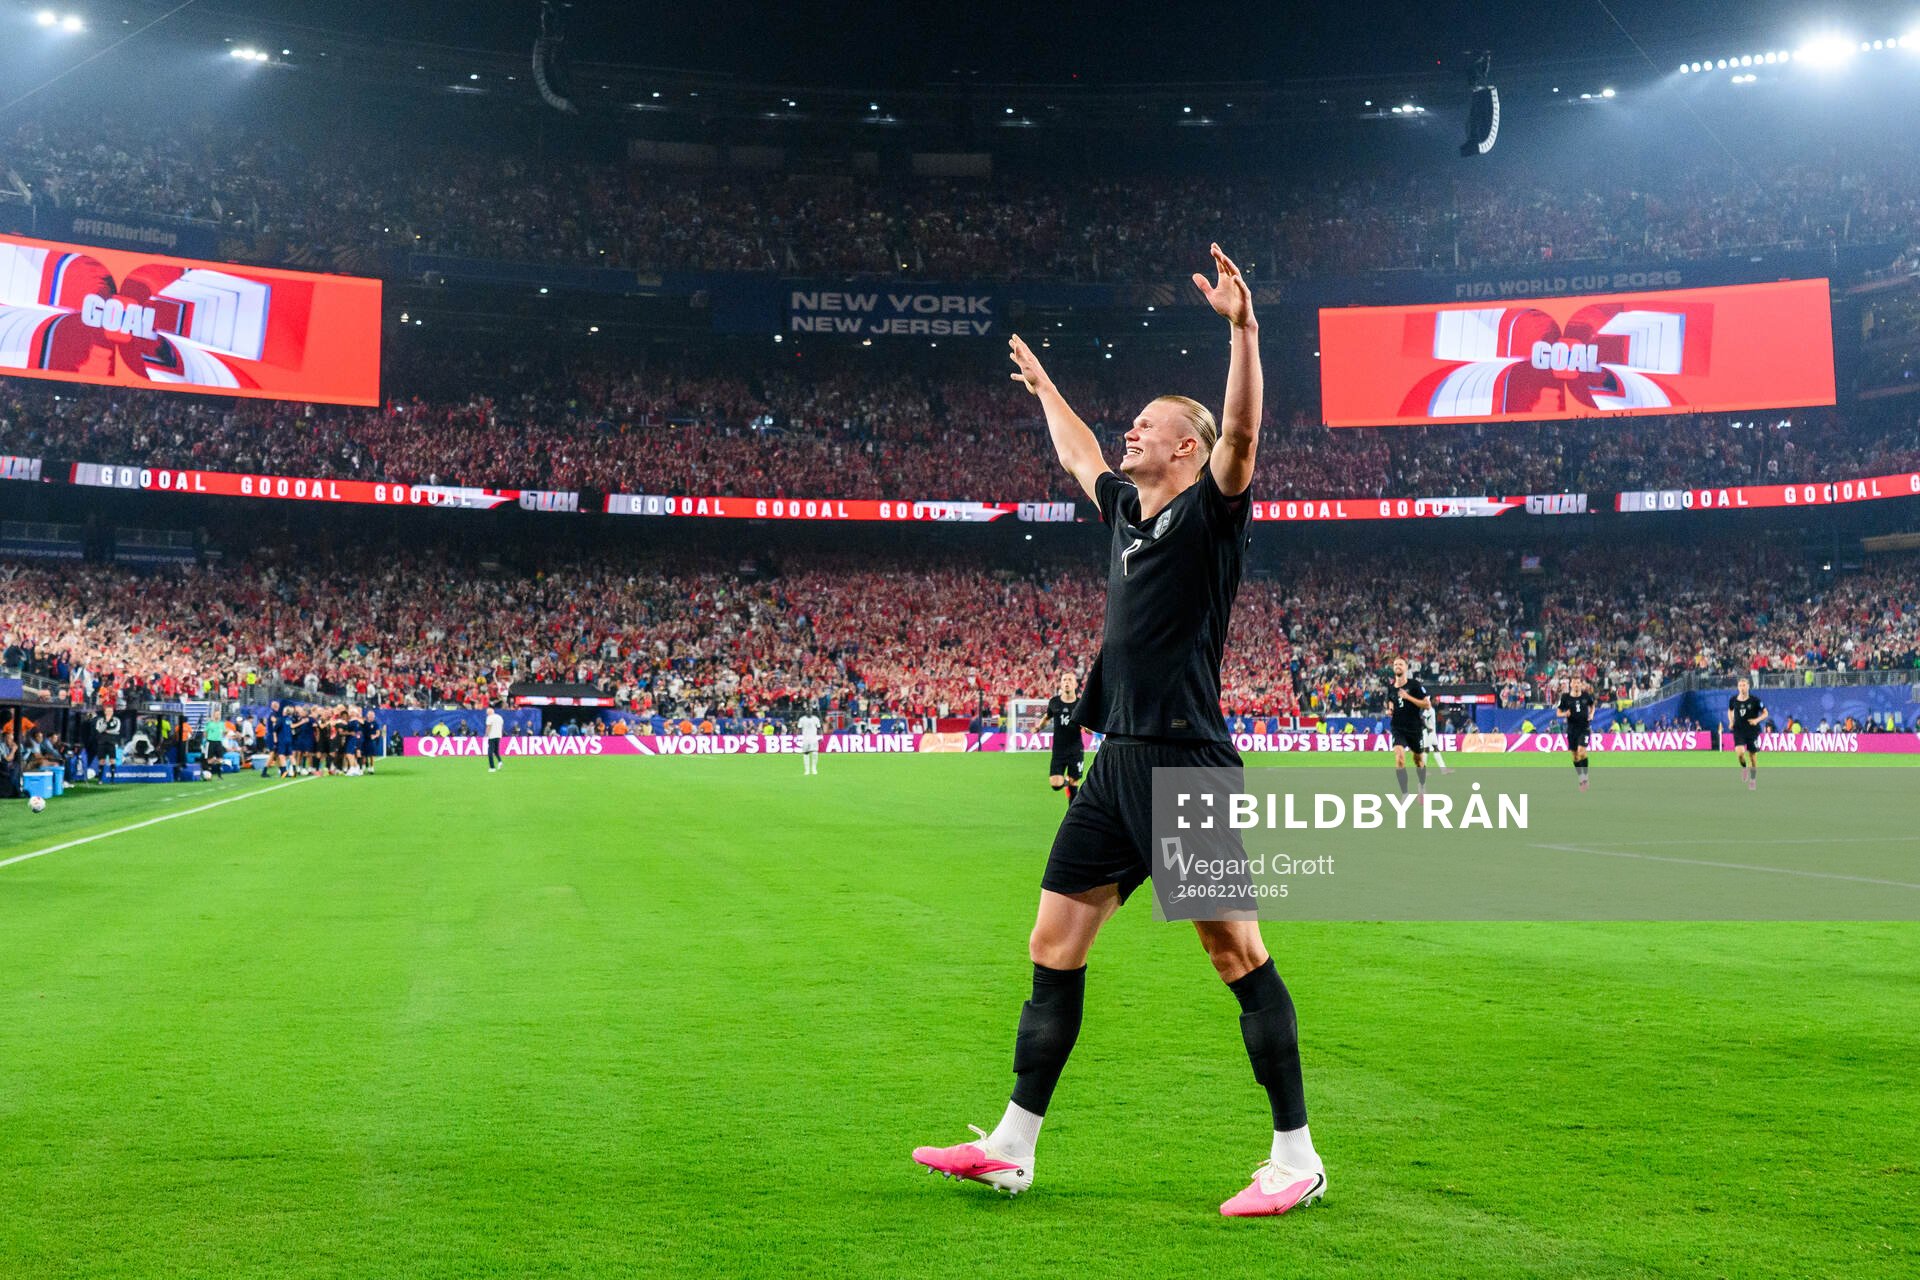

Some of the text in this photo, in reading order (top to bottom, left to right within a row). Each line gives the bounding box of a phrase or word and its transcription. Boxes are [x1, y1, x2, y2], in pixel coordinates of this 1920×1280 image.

[73, 218, 177, 248] #FIFAWorldCup
[1455, 271, 1682, 297] FIFA WORLD CUP 2026
[791, 291, 993, 314] NEW YORK
[81, 293, 158, 340] GOAL
[791, 316, 993, 336] NEW JERSEY
[1531, 340, 1602, 373] GOAL
[100, 466, 207, 491] GOOOAL
[240, 476, 342, 500] GOOOAL
[374, 485, 471, 507] GOOOAL
[1645, 489, 1749, 509] GOOOAL
[1784, 480, 1882, 503] GOOOAL
[631, 497, 725, 515] GOOOAL
[756, 500, 849, 518] GOOOAL
[879, 502, 972, 520] GOOOAL
[1252, 502, 1347, 518] GOOOAL
[1379, 500, 1477, 516] GOOOAL
[418, 735, 603, 757] QATA AIRWAYS
[656, 735, 759, 754] WORLD'S
[766, 734, 823, 754] BES
[826, 734, 914, 753] AIRLINE
[1231, 734, 1311, 752] ORLD'S
[1313, 734, 1368, 751] BEST
[1612, 731, 1697, 751] AIRWAYS
[1801, 732, 1858, 752] AIRWAYS
